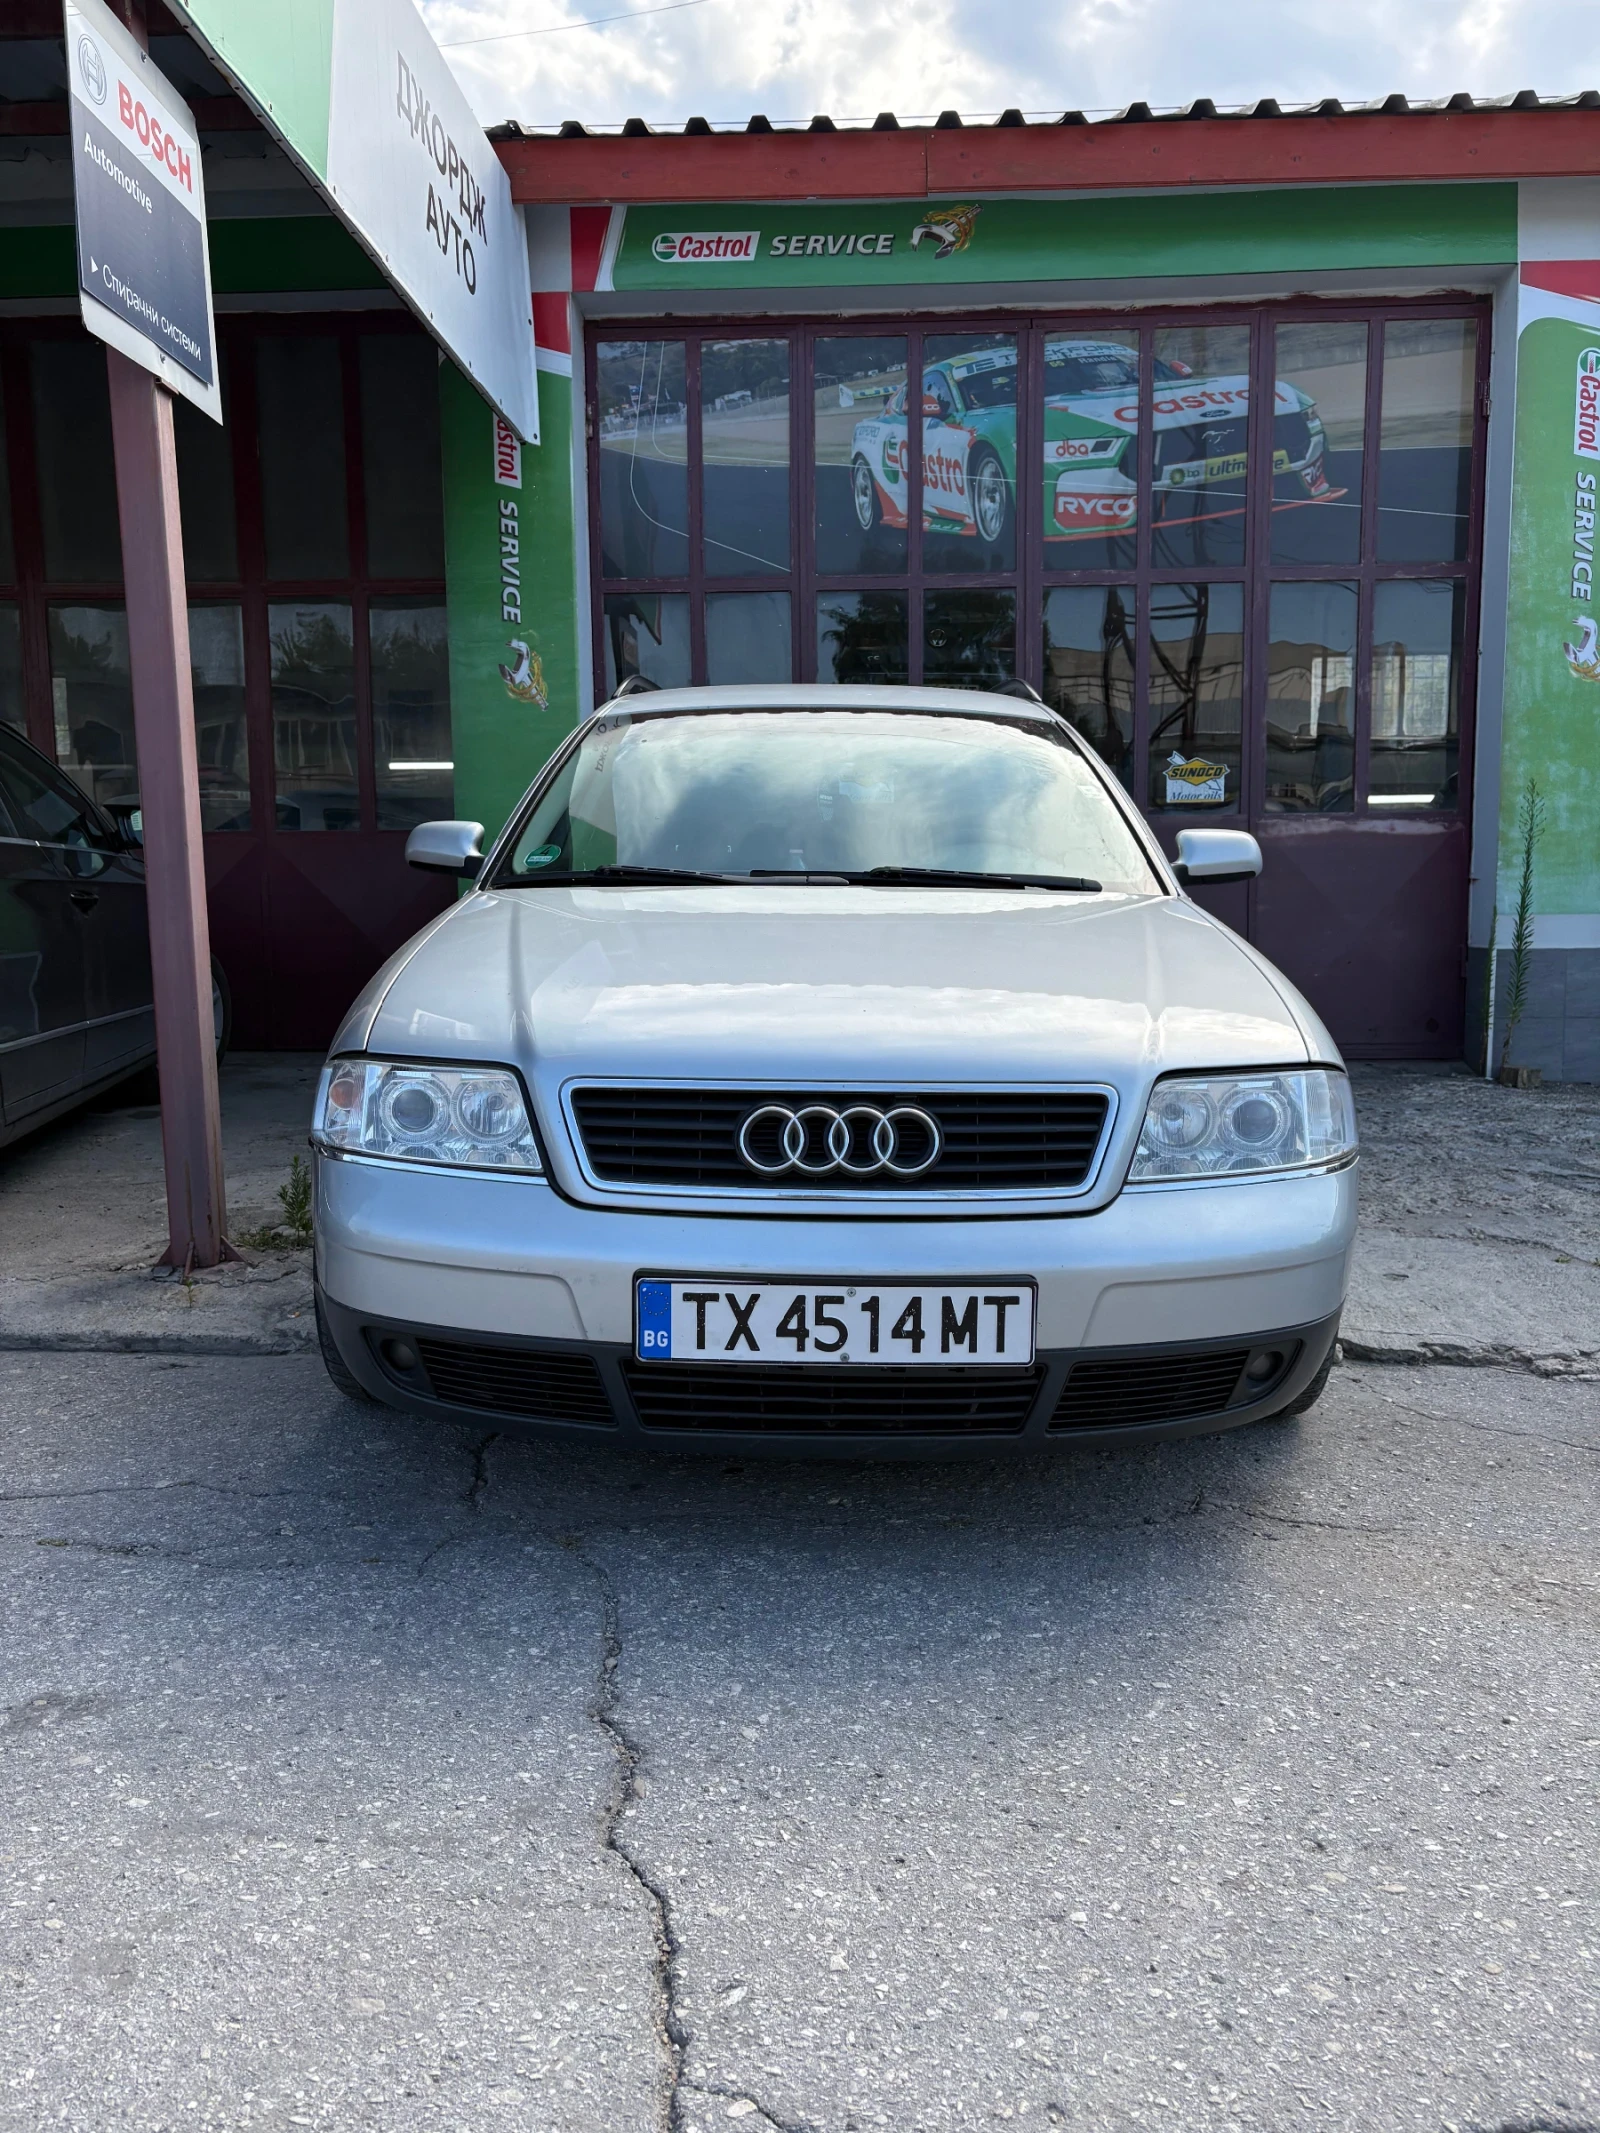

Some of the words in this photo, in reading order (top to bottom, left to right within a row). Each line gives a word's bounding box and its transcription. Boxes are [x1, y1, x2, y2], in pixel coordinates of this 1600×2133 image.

[117, 79, 192, 194] BOSCH
[396, 50, 488, 246] ДЖОРДЖ
[83, 132, 153, 214] Automotive
[426, 182, 476, 295] АУТО
[677, 234, 751, 258] Castrol
[769, 234, 895, 257] SERVICE
[102, 264, 159, 327] Спирачни
[161, 316, 202, 361] системи
[1578, 375, 1600, 451] Castrol
[497, 418, 519, 481] astrol
[1055, 439, 1089, 457] dba
[1185, 468, 1200, 481] bp
[1209, 457, 1284, 477] ultime
[1057, 496, 1136, 517] RYCO
[1572, 471, 1597, 600] SERVICE
[500, 499, 521, 625] SERVICE
[1170, 791, 1201, 801] Motor
[1204, 791, 1222, 800] oils
[1171, 767, 1223, 778] SUNOCO
[643, 1330, 668, 1348] BG
[682, 1292, 760, 1352] TX
[775, 1294, 925, 1353] 4514
[941, 1296, 1020, 1353] MT
